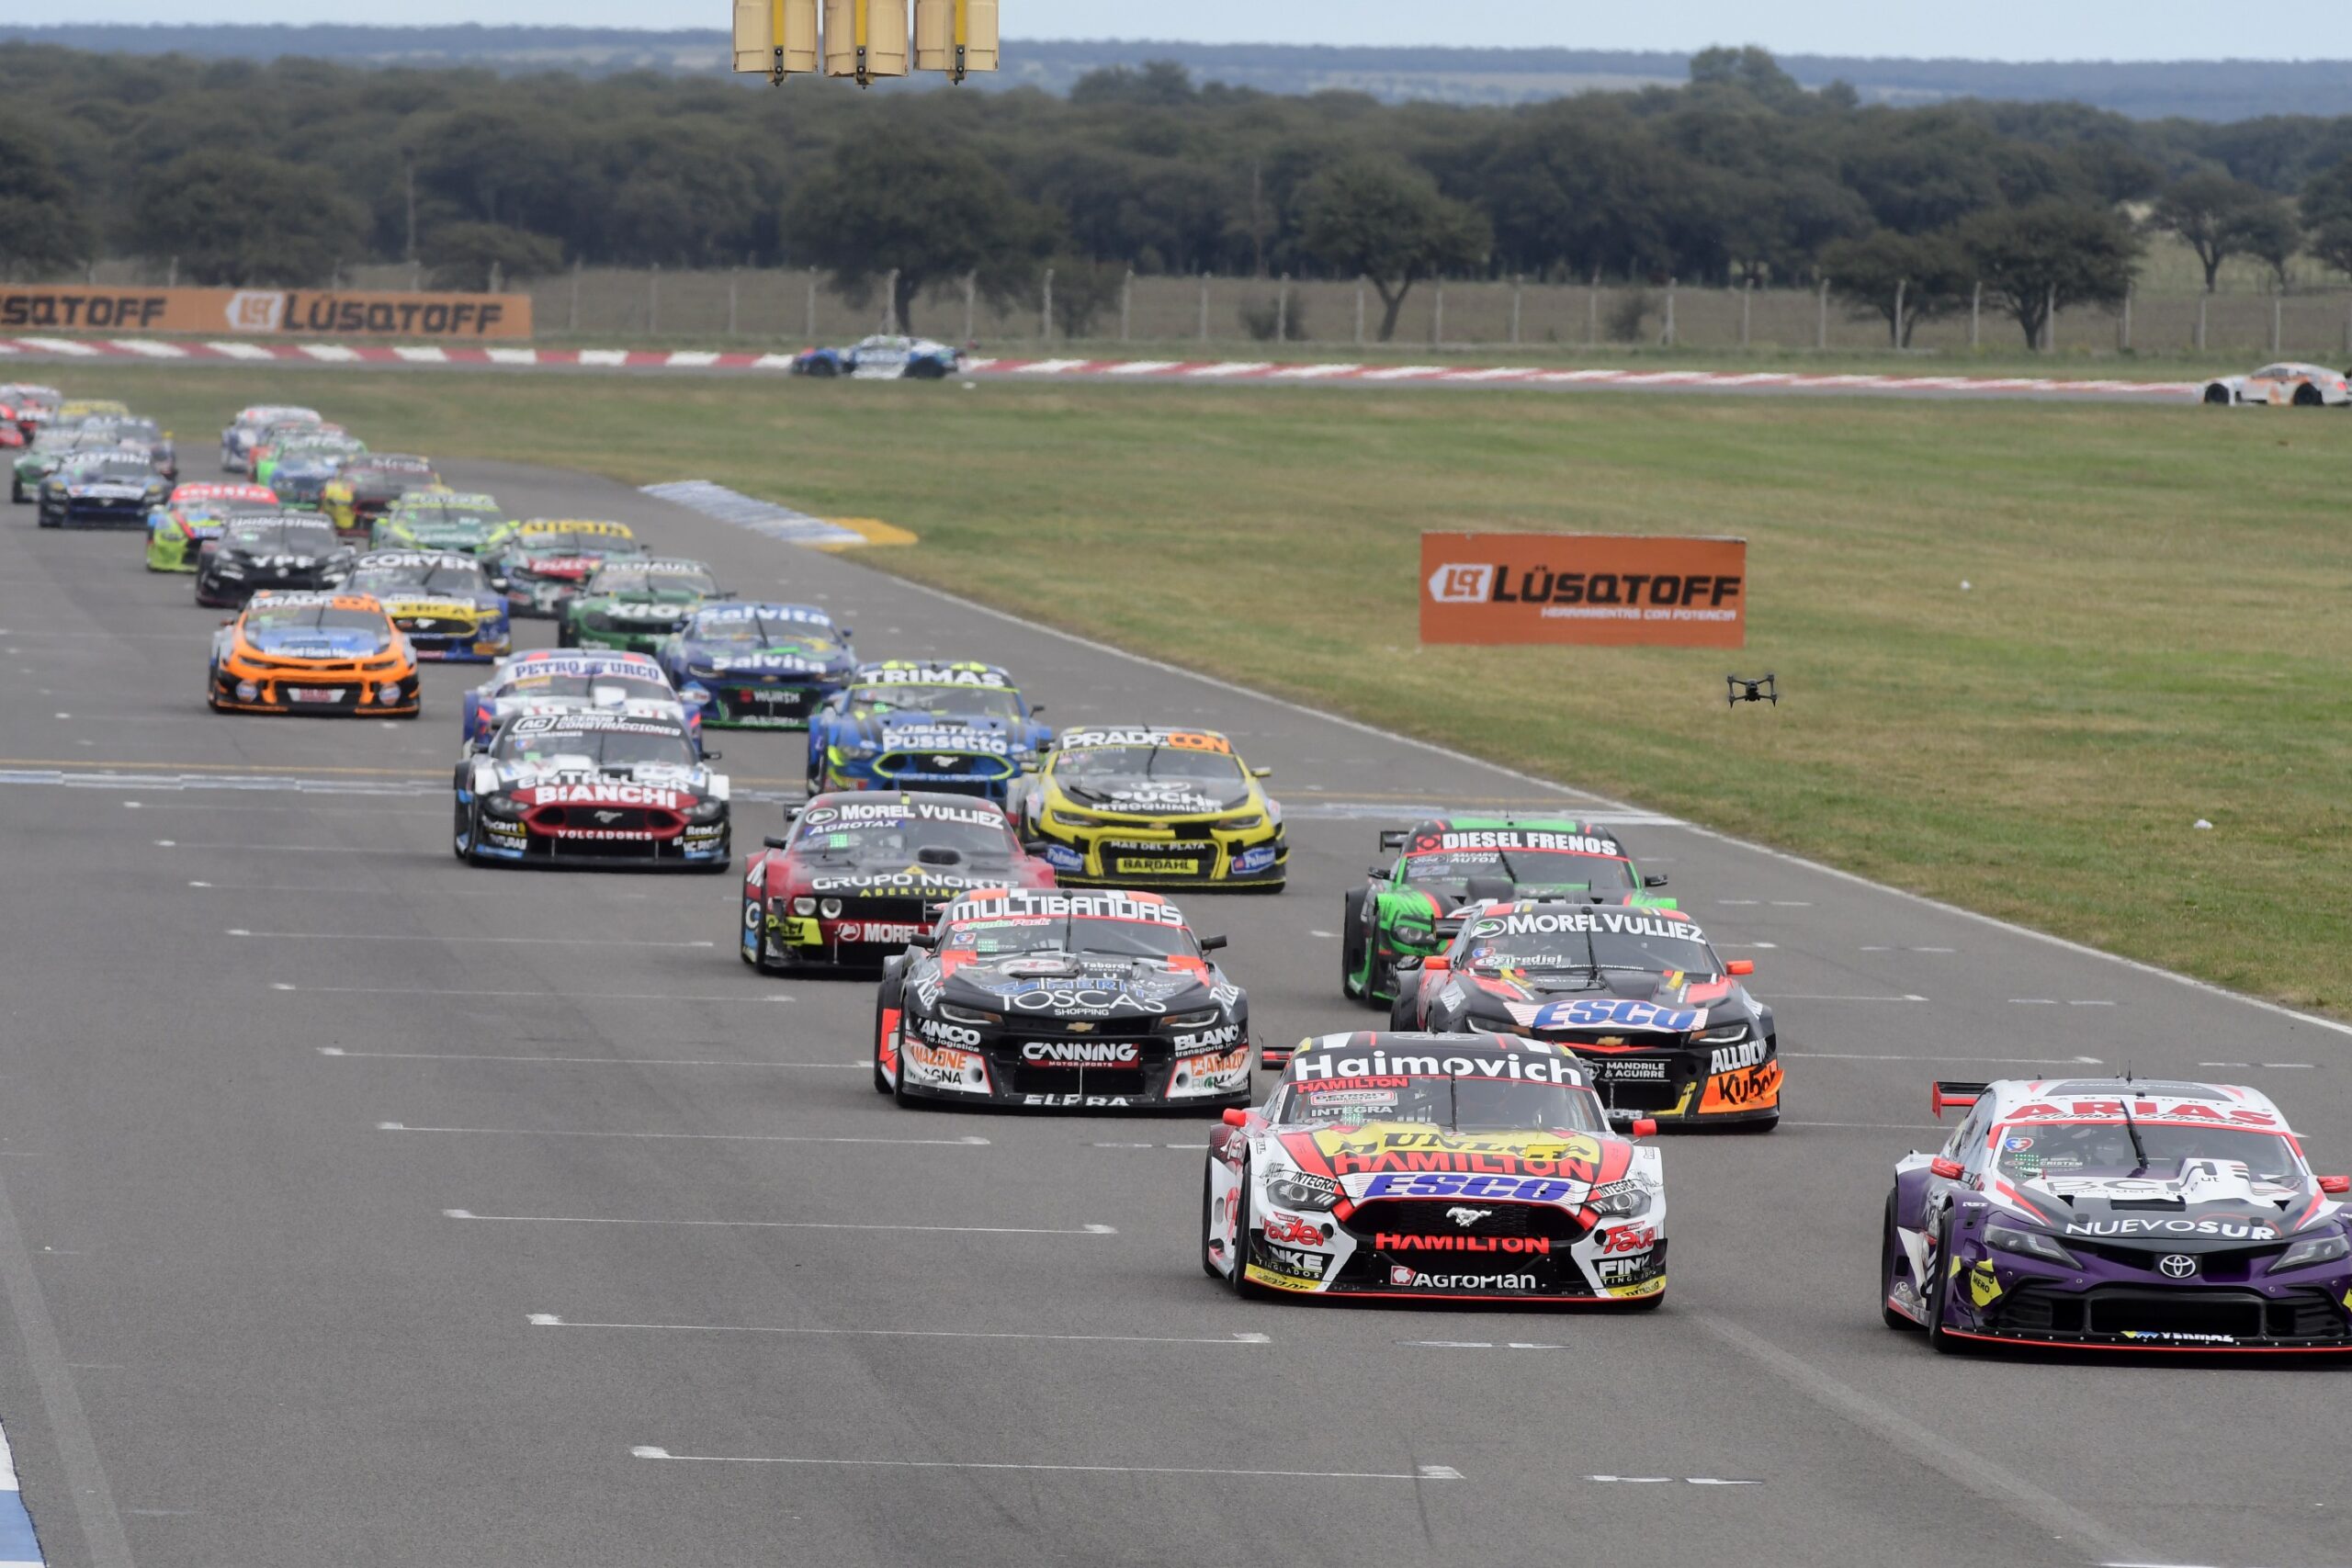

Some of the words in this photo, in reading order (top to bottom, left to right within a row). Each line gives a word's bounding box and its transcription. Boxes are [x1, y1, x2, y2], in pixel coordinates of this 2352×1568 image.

[358, 553, 479, 570] CORVEN
[1492, 566, 1742, 606] LÜSQTOFF
[1644, 608, 1671, 620] CON
[514, 660, 581, 678] PETRO
[862, 668, 1005, 687] TRIMAS
[556, 721, 682, 737] CONSTRUCCIONES
[535, 785, 677, 809] BIANCHI
[841, 806, 916, 821] MOREL
[919, 805, 1005, 829] VULLIEZ
[557, 829, 653, 840] VOLCADORES
[809, 819, 900, 835] AGROTAX
[1111, 841, 1138, 851] MAR
[1169, 842, 1206, 852] PLATA
[1442, 832, 1521, 850] DIESEL
[1526, 833, 1617, 856] FRENOS
[1123, 859, 1192, 872] BARDAHL
[811, 874, 907, 890] GRUPO
[924, 874, 1019, 889] NORTE
[952, 896, 1184, 927] MULTIBANDAS
[1507, 914, 1602, 935] MOREL
[1602, 914, 1706, 944] VULLIEZ
[1054, 1008, 1110, 1017] SHOPPING
[1532, 999, 1702, 1032] ESCO
[1022, 1042, 1139, 1062] CANNING
[1295, 1050, 1583, 1087] Haimovich
[1607, 1062, 1665, 1070] MANDRILE
[1615, 1069, 1665, 1078] AGUIRRE
[1297, 1077, 1408, 1093] HAMILTON
[1311, 1106, 1394, 1117] INTEGRA
[2004, 1100, 2277, 1126] ARIAS
[1334, 1151, 1594, 1184] HAMILTON
[1291, 1170, 1338, 1192] INTEGRA
[1363, 1174, 1572, 1201] ESCO
[1595, 1179, 1638, 1198] INTEGRA
[1375, 1233, 1549, 1254] HAMILTON
